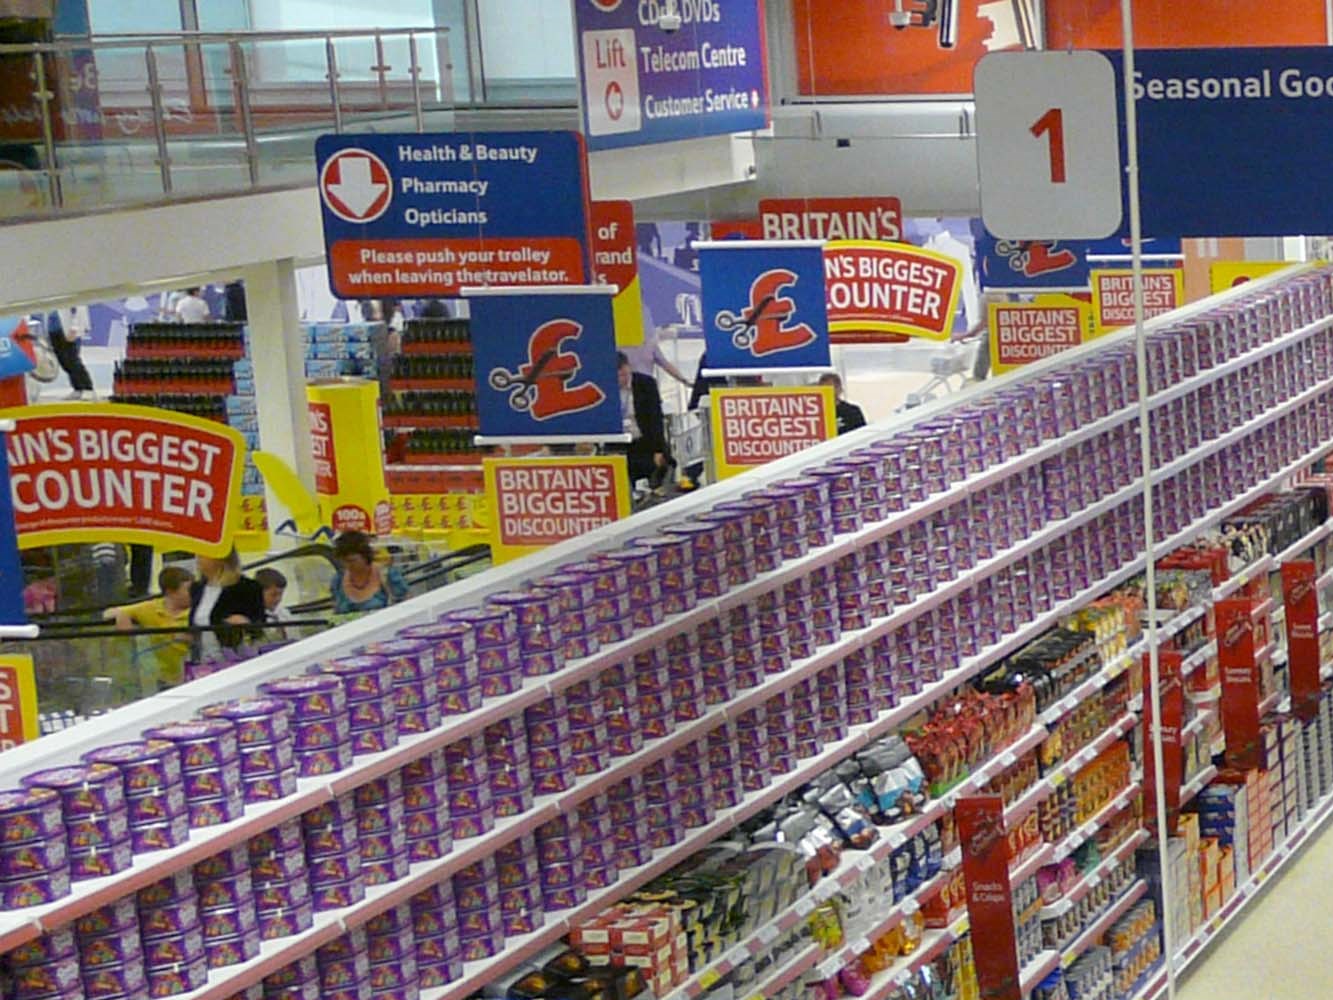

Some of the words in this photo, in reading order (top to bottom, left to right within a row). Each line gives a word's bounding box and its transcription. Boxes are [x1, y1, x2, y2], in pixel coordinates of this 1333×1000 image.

[683, 0, 720, 24] DVDs
[595, 39, 627, 69] Lift
[641, 46, 699, 73] Telecom
[702, 42, 746, 67] Centre
[1133, 69, 1271, 100] Seasonal
[645, 94, 704, 119] Customer
[706, 88, 748, 111] Service
[399, 145, 456, 163] Health
[459, 145, 473, 161] &
[477, 145, 537, 165] Beauty
[1029, 108, 1067, 184] 1
[402, 178, 488, 196] Pharmacy
[405, 208, 487, 228] Opticians
[763, 207, 900, 241] BRITAIN'S
[597, 223, 618, 240] of
[360, 249, 412, 265] Please
[416, 249, 455, 266] push
[460, 251, 497, 266] your
[498, 248, 550, 264] trolley
[596, 248, 633, 265] rand
[349, 271, 391, 285] when
[395, 270, 453, 286] leaving
[456, 269, 484, 283] the
[485, 269, 569, 283] travelator.
[824, 256, 856, 278] N'S
[859, 257, 947, 290] BIGGEST
[1101, 276, 1172, 291] BRITIN'S
[826, 283, 941, 319] OUNTER
[1102, 291, 1172, 306] BIGEST
[1000, 309, 1076, 326] BRITAIN'S
[1001, 326, 1077, 342] BIGGEST
[724, 396, 819, 417] BRITAIN'S
[726, 417, 821, 437] BIGGEST
[79, 431, 221, 474] BIGGEST
[500, 467, 611, 491] BRITAIN'S
[11, 469, 214, 523] COUNTER
[502, 491, 609, 515] BIGGEST
